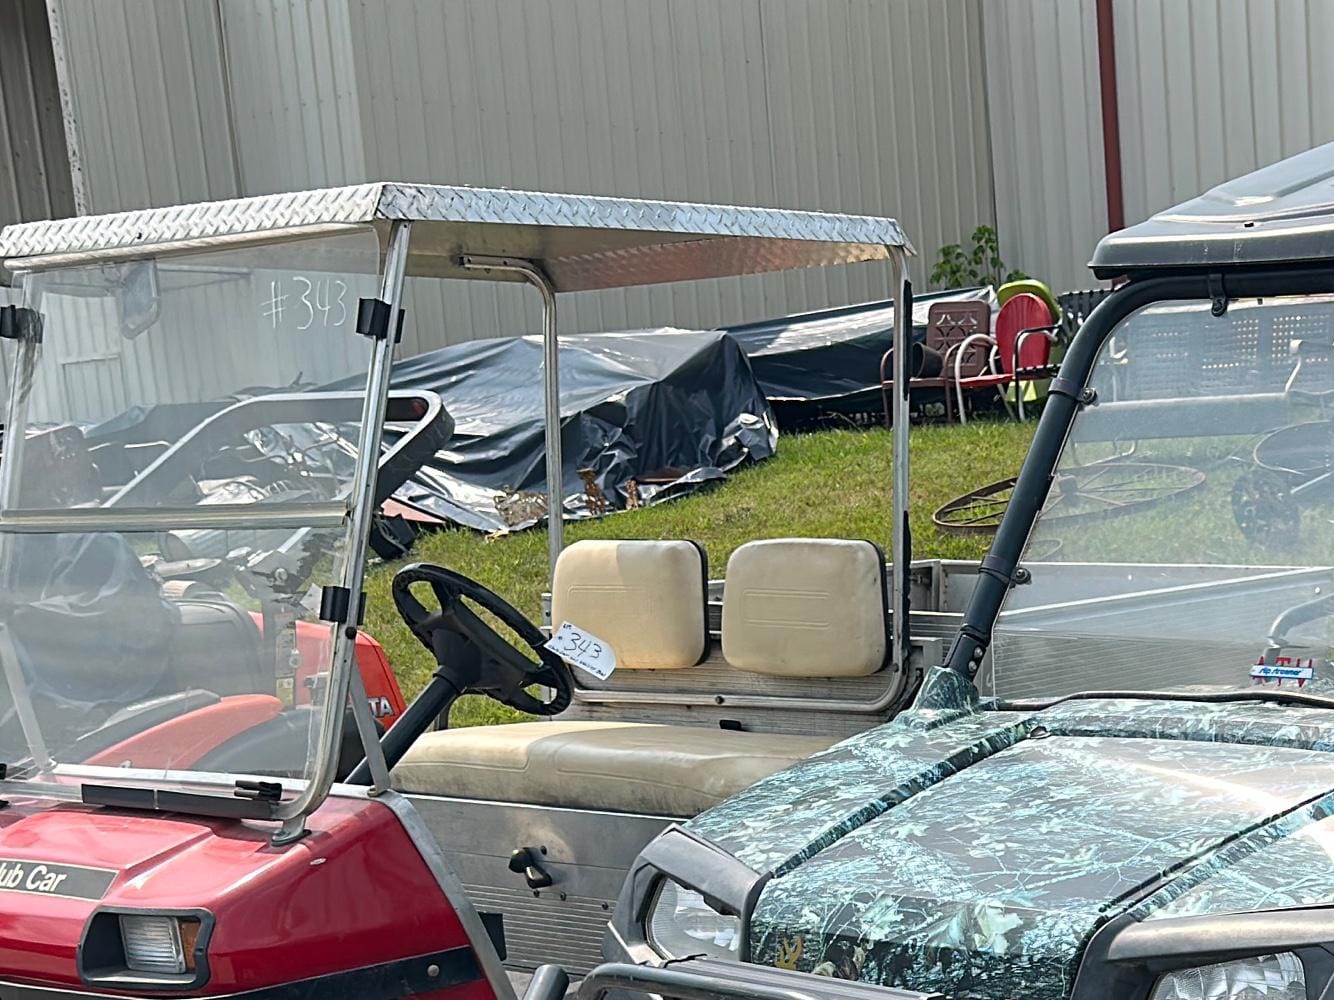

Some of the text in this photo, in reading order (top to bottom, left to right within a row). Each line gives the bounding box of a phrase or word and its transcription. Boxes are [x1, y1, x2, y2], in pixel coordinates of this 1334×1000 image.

[260, 276, 347, 330] #343
[563, 632, 602, 659] 343
[25, 864, 68, 893] Car
